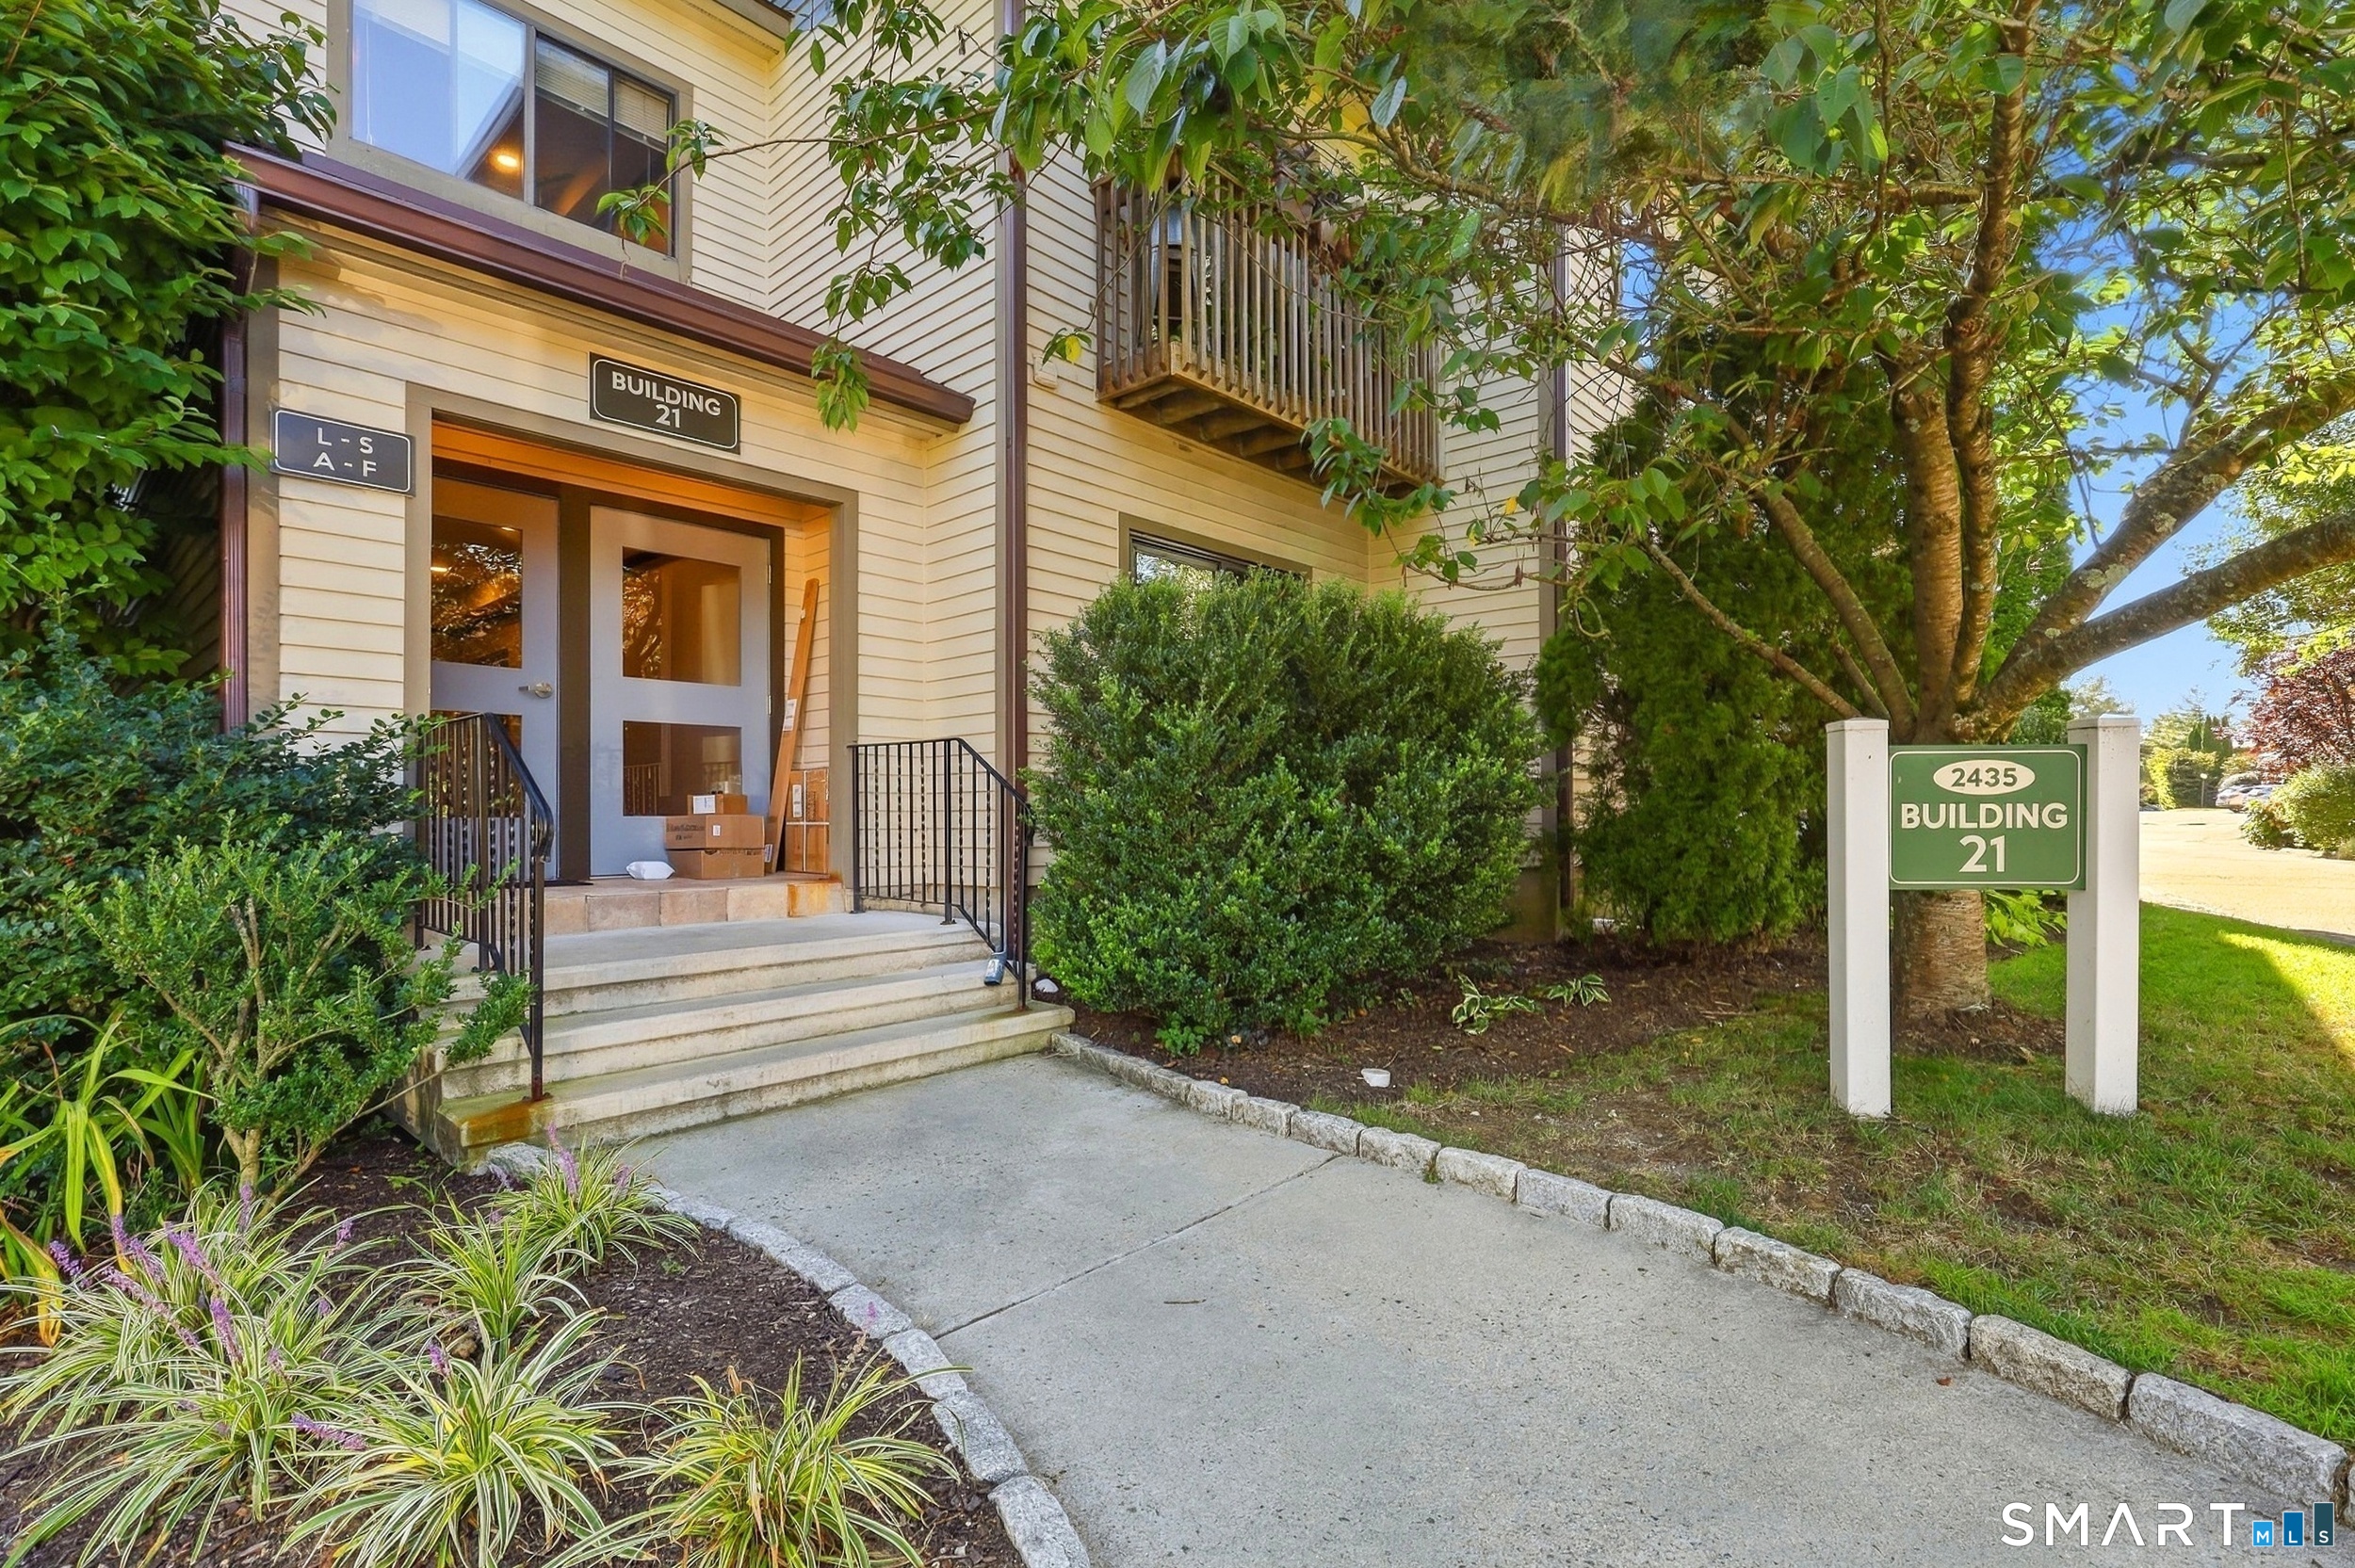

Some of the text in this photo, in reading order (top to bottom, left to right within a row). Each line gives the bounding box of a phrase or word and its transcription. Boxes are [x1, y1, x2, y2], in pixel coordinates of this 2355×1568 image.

[612, 371, 721, 416] BUILDING
[656, 403, 680, 428] 21
[317, 427, 333, 446] L
[359, 436, 374, 454] S
[313, 451, 335, 471] A
[363, 460, 377, 477] F
[1951, 768, 2018, 787] 2435
[1901, 802, 2068, 829] BUILDING
[1958, 834, 2006, 873] 21
